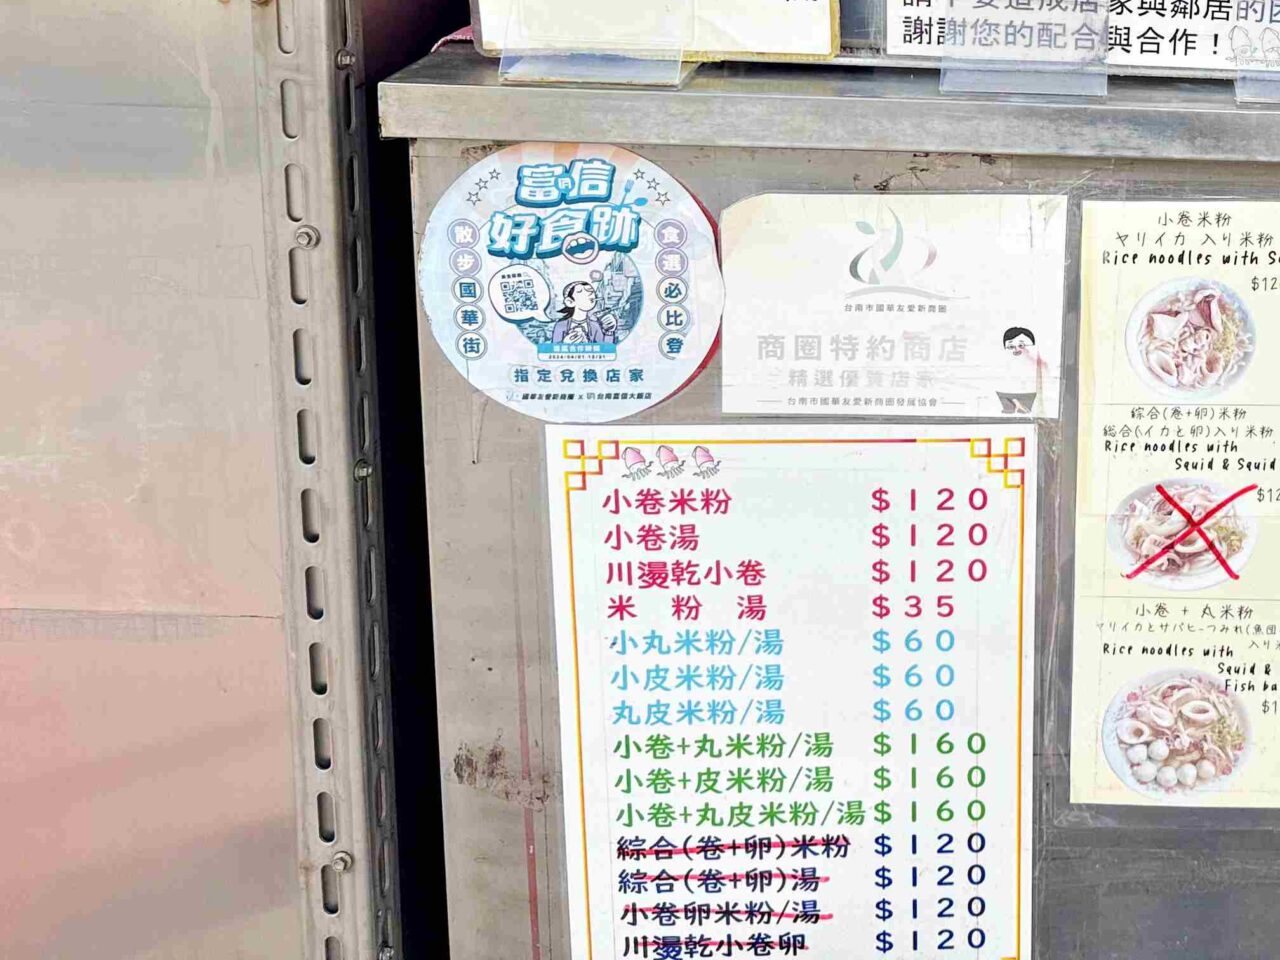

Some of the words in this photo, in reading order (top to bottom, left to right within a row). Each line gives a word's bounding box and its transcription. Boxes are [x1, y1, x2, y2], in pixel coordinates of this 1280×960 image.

[517, 159, 615, 207] 富信
[1158, 211, 1232, 228] 小卷米粉
[1102, 250, 1138, 266] Rice
[1149, 251, 1212, 266] noodles
[1222, 251, 1259, 266] with
[756, 334, 967, 362] 商圈特約商店
[514, 368, 644, 383] 指定兌換店家
[788, 369, 936, 388] 精選優質店家
[1104, 440, 1136, 453] Rice
[1144, 440, 1198, 453] noodles
[1206, 440, 1238, 453] with
[1175, 457, 1214, 471] Squid
[1222, 457, 1230, 470] &
[1237, 458, 1276, 471] Squid
[602, 487, 732, 515] 小卷米粉
[604, 523, 700, 552] 小卷湯
[613, 628, 784, 656] 小丸米粉/湯
[1103, 643, 1133, 655] Rice
[1141, 643, 1194, 657] noodles
[1203, 644, 1234, 657] with
[611, 664, 784, 691] 小皮米粉/湯
[1217, 662, 1256, 675] Squid
[1264, 663, 1271, 675] &
[1225, 679, 1255, 692] Fish
[612, 698, 786, 725] 丸皮米粉/湯
[613, 732, 834, 760] 小卷+丸米粉/湯
[614, 765, 834, 794] 小卷+皮米粉/湯
[615, 799, 866, 828] 小卷+丸皮米粉/湯
[616, 834, 850, 861] 綜合(卷+卵)米粉
[617, 868, 820, 895] 綜合(卷+卵)湯
[620, 901, 820, 926] 小卷卵米粉/湯
